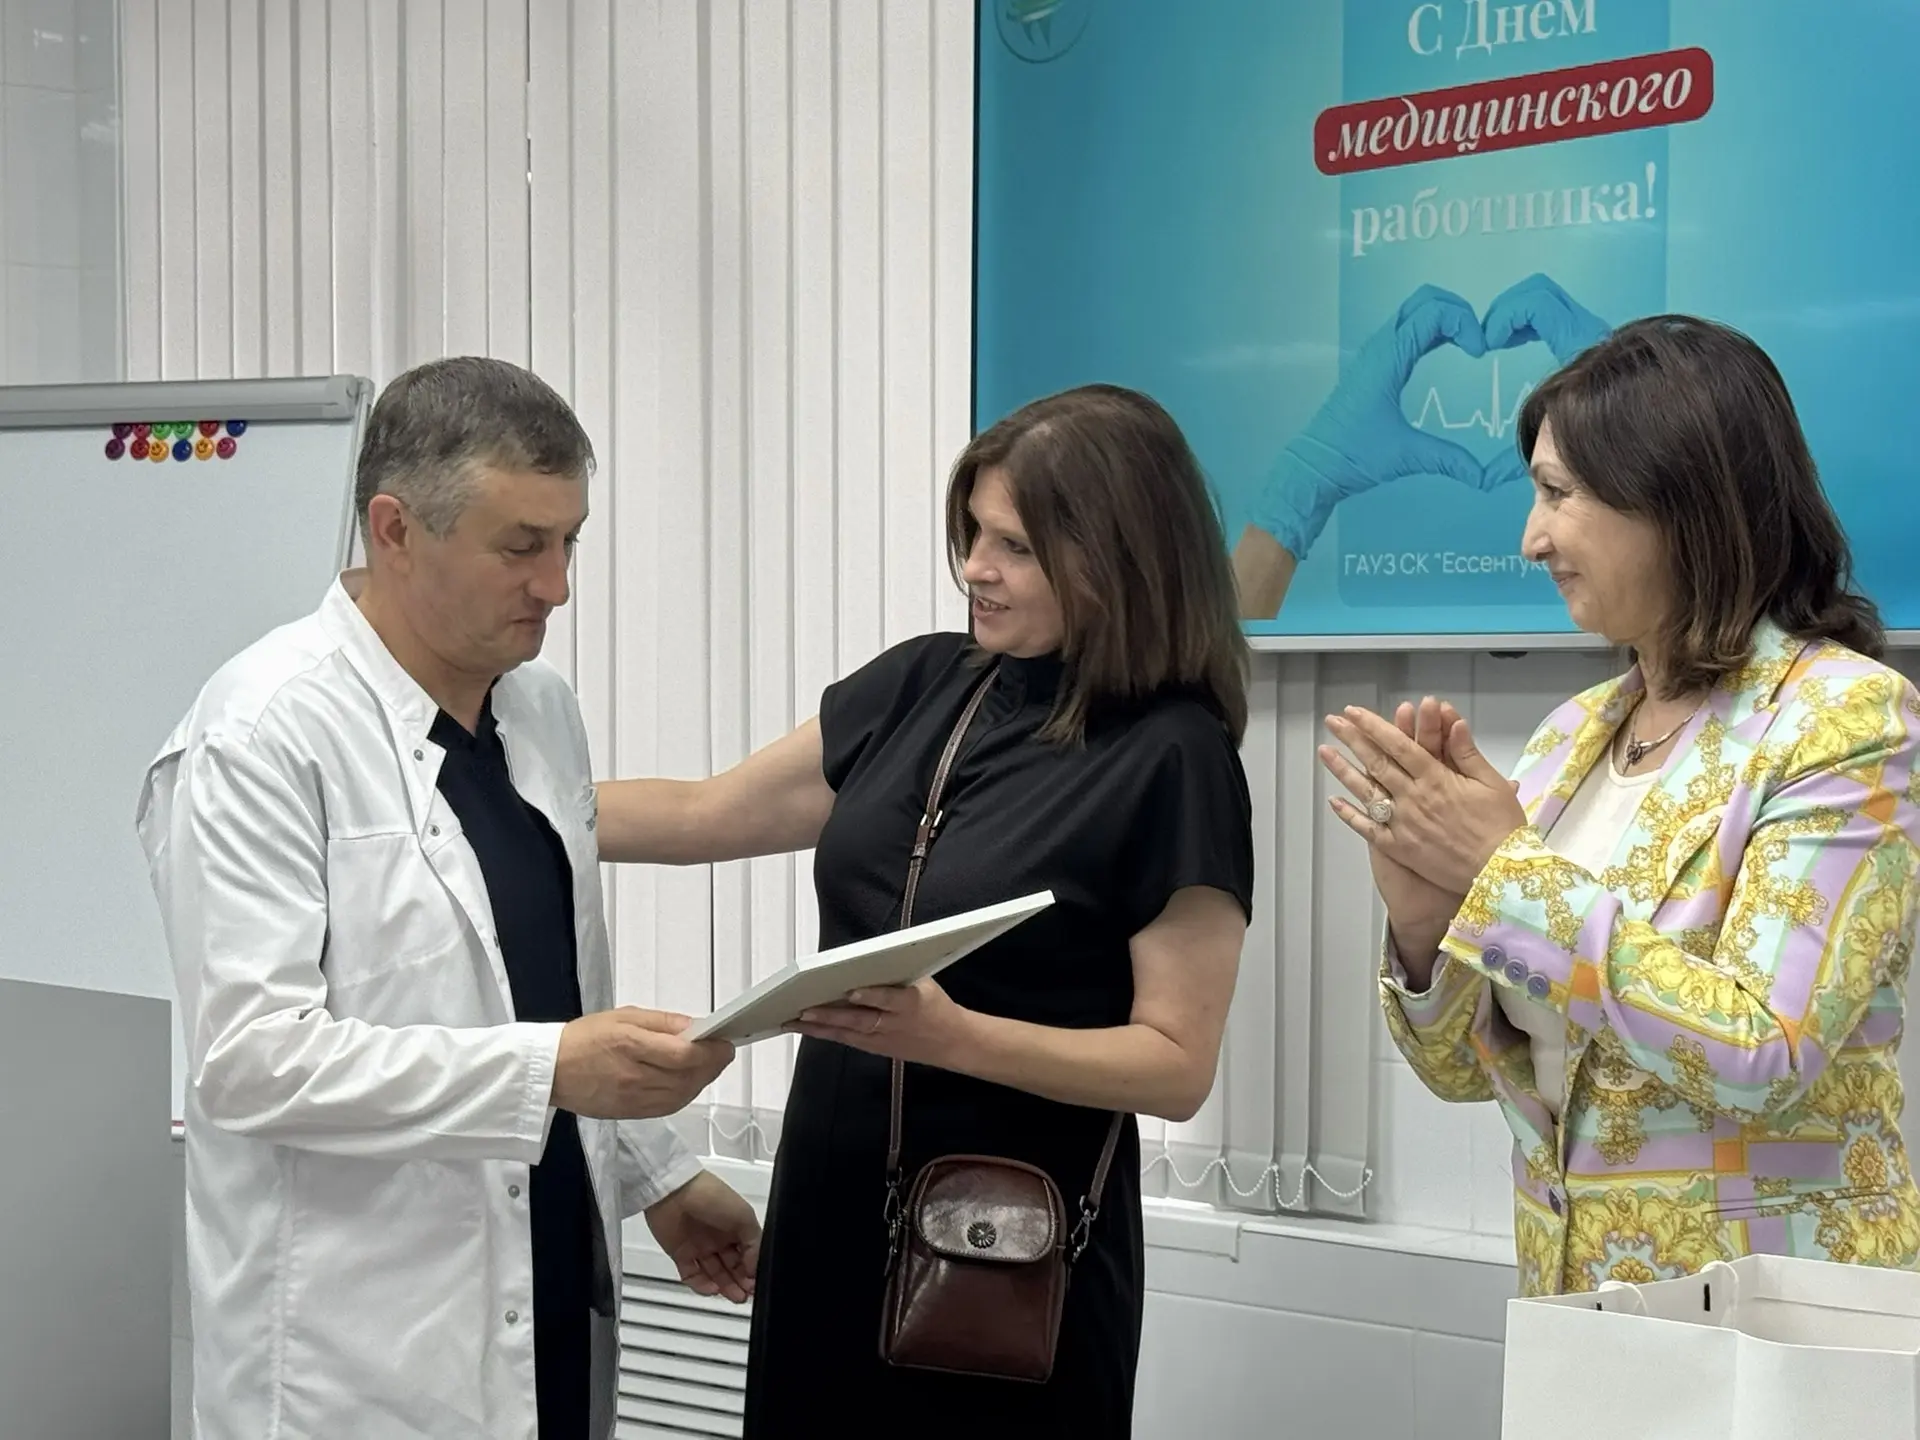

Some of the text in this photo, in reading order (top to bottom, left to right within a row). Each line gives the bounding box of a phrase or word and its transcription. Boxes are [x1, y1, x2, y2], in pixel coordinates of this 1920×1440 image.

[1408, 0, 1597, 60] С Днем
[1327, 67, 1693, 162] медицинского
[1351, 160, 1657, 257] работника!
[1344, 553, 1396, 576] ГАУЗ
[1400, 552, 1430, 575] СК
